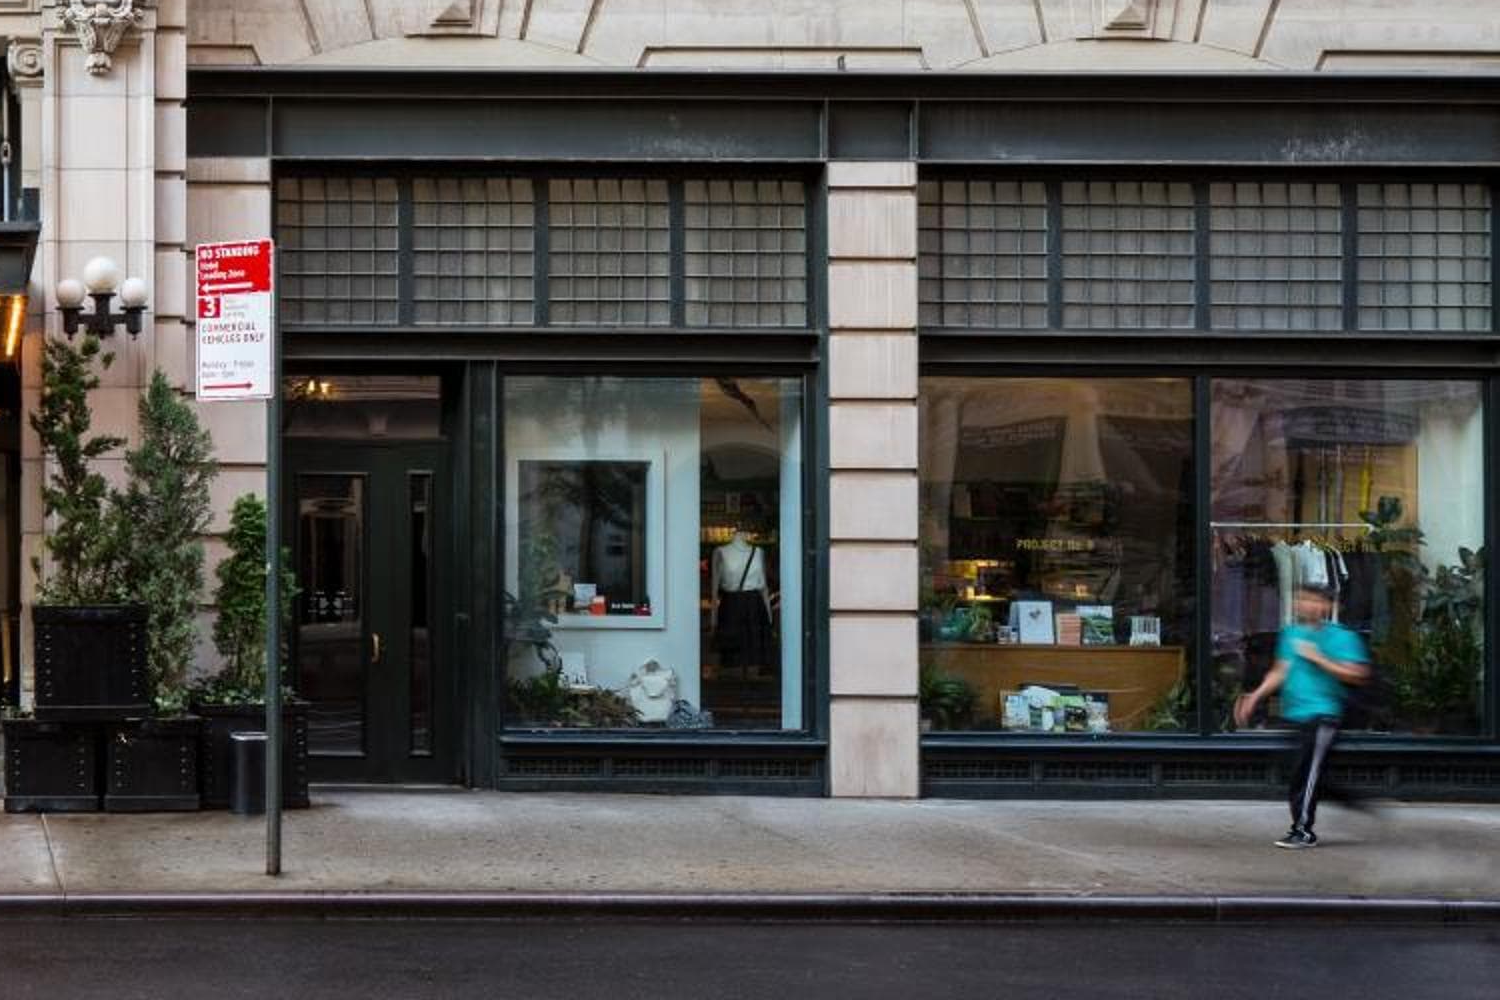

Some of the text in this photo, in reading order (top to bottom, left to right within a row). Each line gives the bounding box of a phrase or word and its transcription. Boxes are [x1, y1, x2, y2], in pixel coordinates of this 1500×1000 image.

[200, 244, 260, 259] NO STANDING
[203, 297, 216, 316] 3
[201, 321, 255, 333] COMMERCIAL
[201, 332, 266, 345] VEHICLES ONLY
